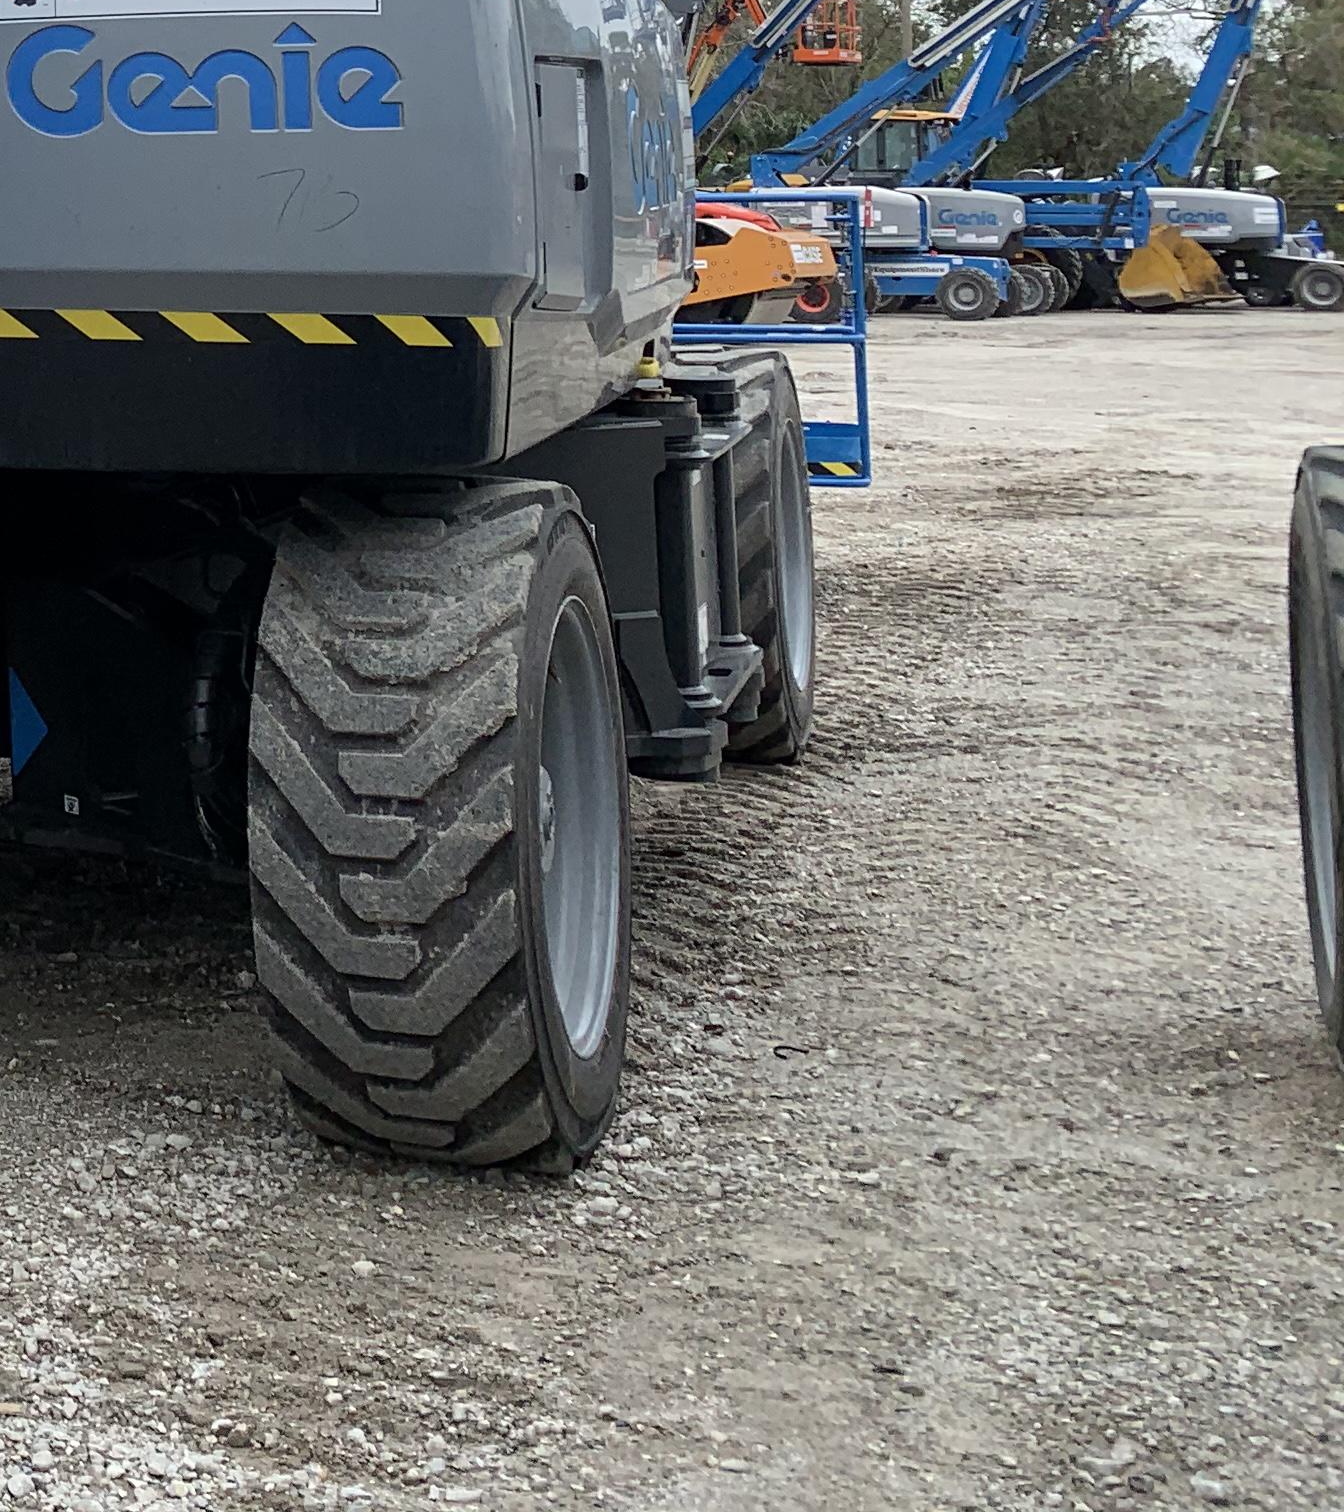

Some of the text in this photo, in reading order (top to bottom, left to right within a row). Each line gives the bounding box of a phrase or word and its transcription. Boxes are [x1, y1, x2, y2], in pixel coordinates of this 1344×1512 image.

[6, 22, 404, 137] Genie
[938, 208, 998, 226] Genie
[1166, 207, 1229, 224] Genie
